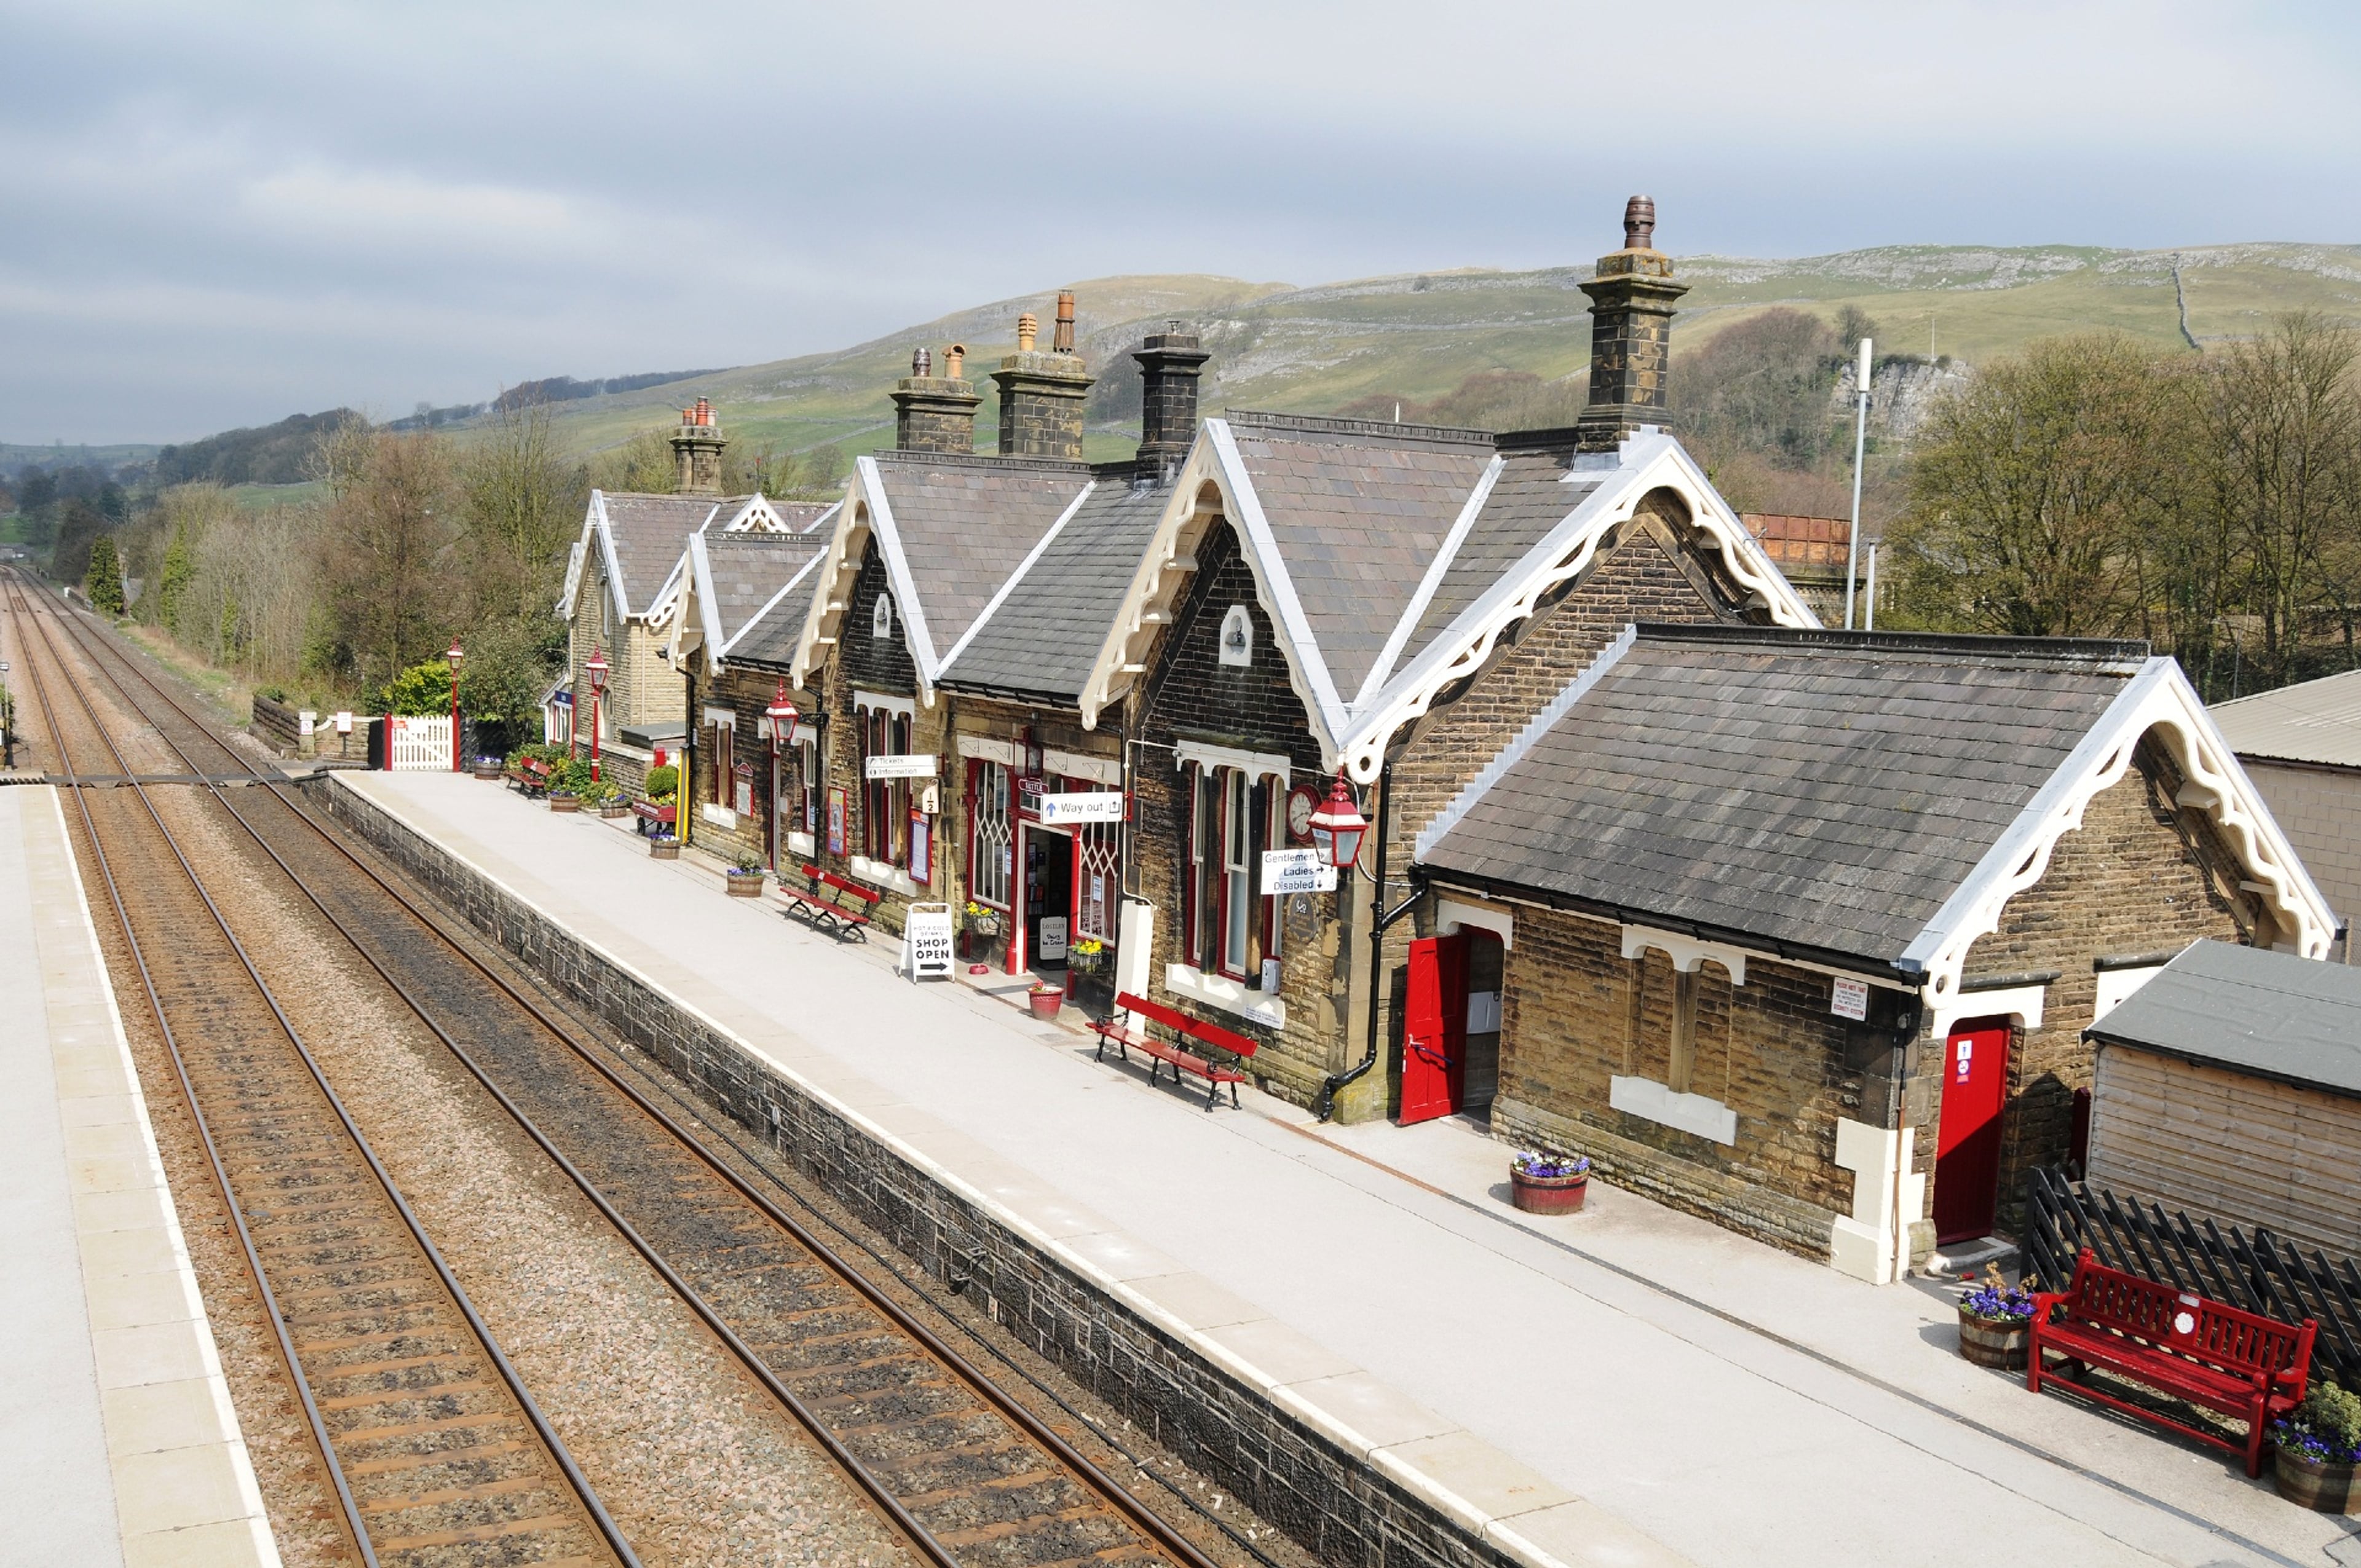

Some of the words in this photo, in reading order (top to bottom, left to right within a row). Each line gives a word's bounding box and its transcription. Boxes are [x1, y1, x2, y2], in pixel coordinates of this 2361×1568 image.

[1061, 802, 1083, 814] Way
[1087, 802, 1103, 812] out
[1265, 853, 1315, 863] Gentlemen
[1284, 867, 1315, 876] Ladies
[1273, 880, 1314, 890] Disabled
[916, 938, 948, 948] SHOP
[916, 949, 949, 959] OPEN
